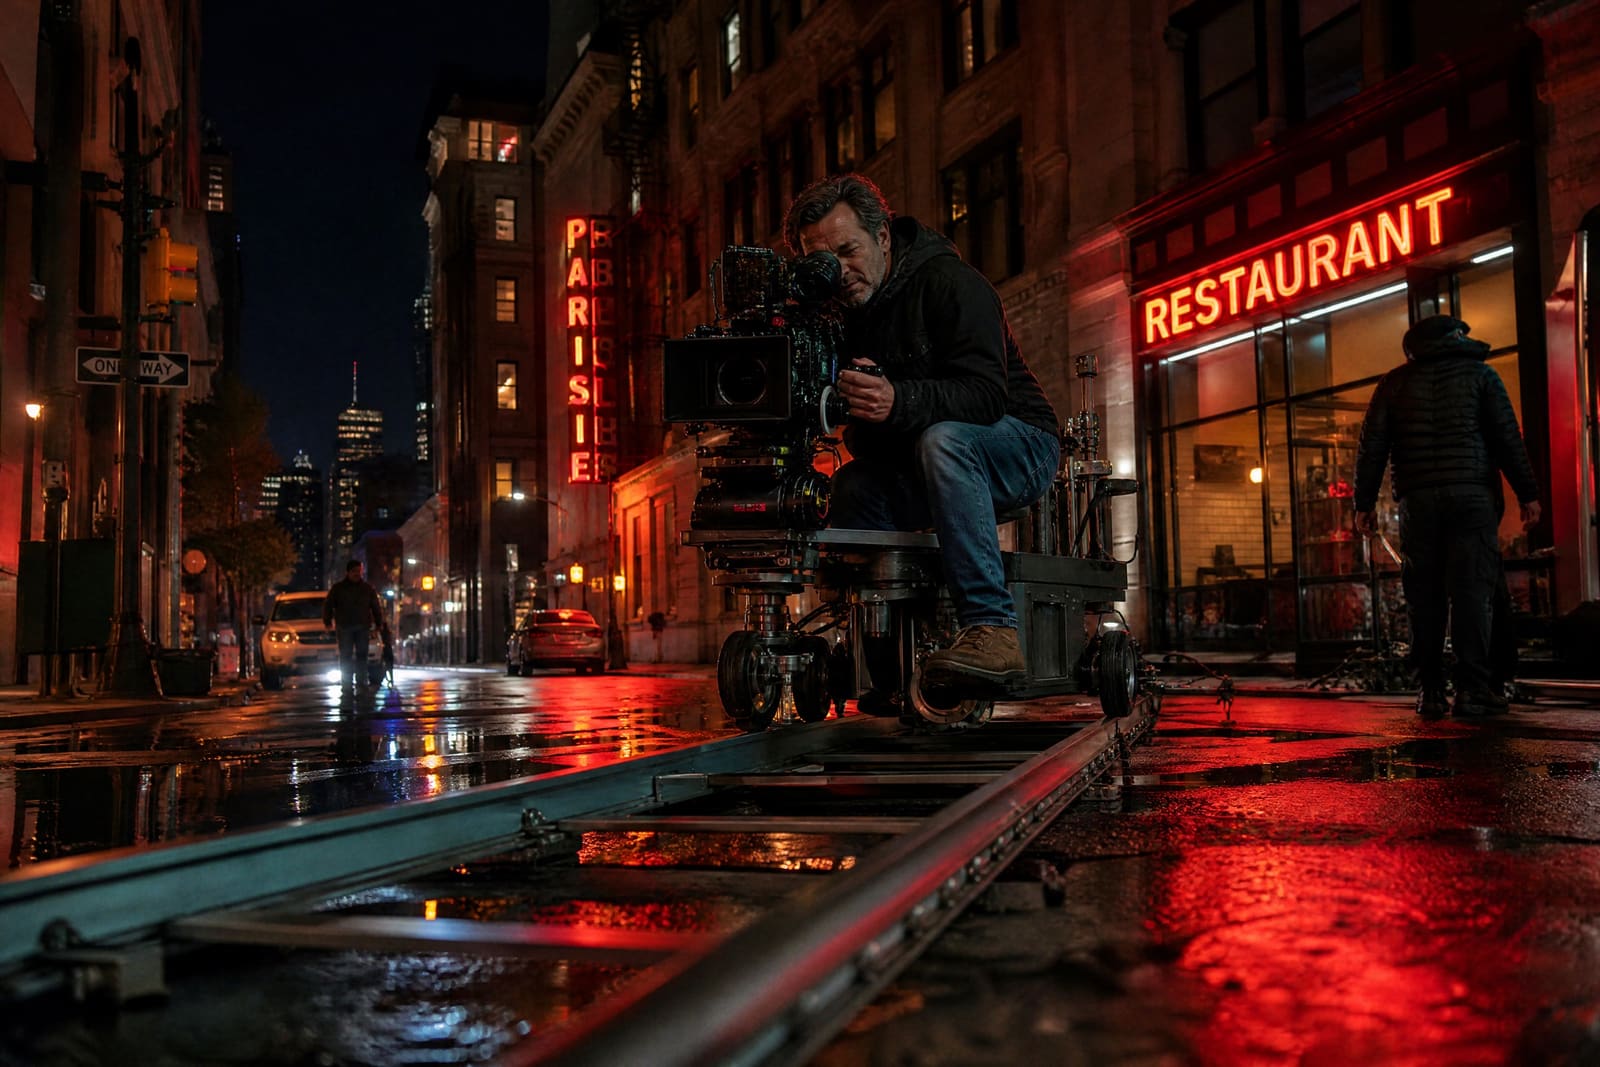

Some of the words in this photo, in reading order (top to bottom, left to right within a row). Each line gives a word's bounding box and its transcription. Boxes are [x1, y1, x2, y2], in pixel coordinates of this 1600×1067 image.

[1145, 187, 1452, 344] RESTAURANT
[94, 360, 120, 373] ON
[142, 362, 173, 376] WAY
[567, 218, 590, 481] PARISIE
